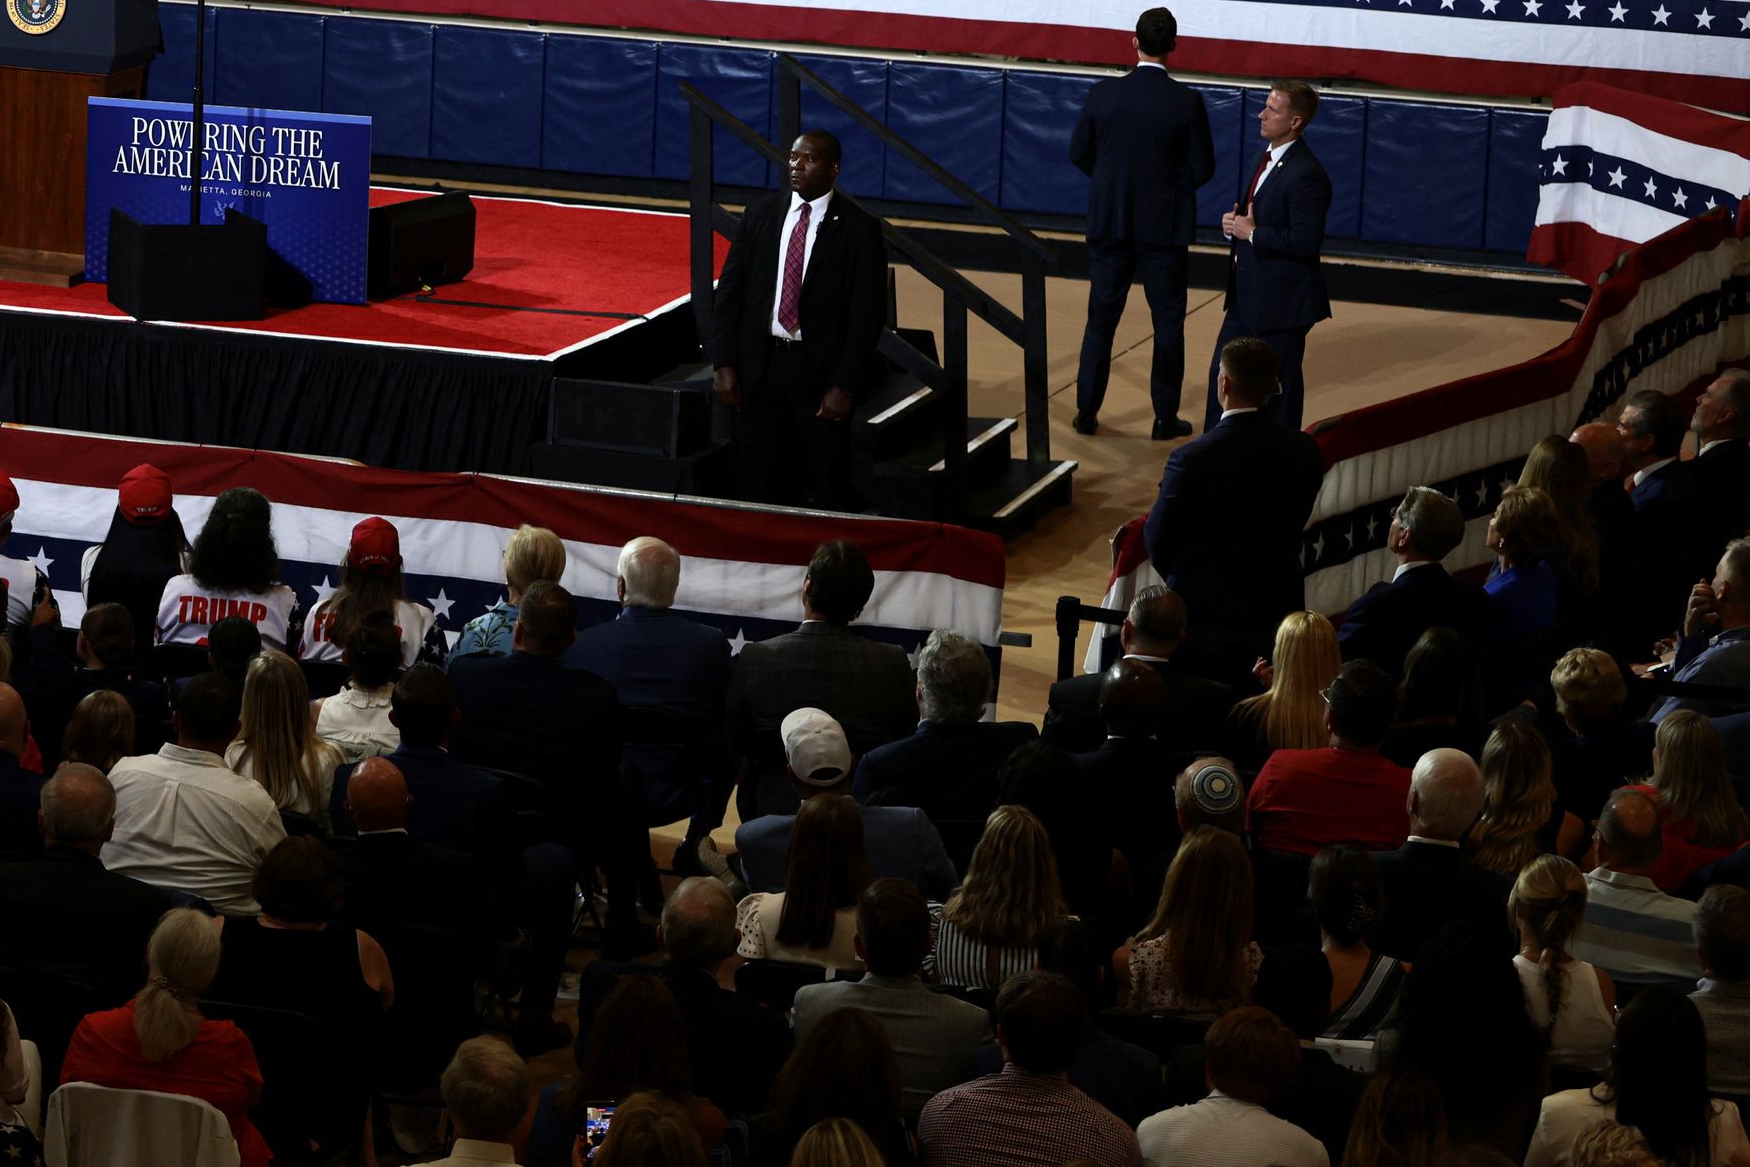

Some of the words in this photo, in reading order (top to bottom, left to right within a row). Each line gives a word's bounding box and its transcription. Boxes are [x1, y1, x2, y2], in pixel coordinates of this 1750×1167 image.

[39, 13, 62, 32] STATES
[131, 116, 266, 155] POWRING
[272, 127, 324, 159] THE
[251, 154, 340, 190] DREAM
[180, 184, 228, 196] MAIETTA,
[231, 188, 272, 199] GEORGIA
[179, 596, 267, 626] TRUMP
